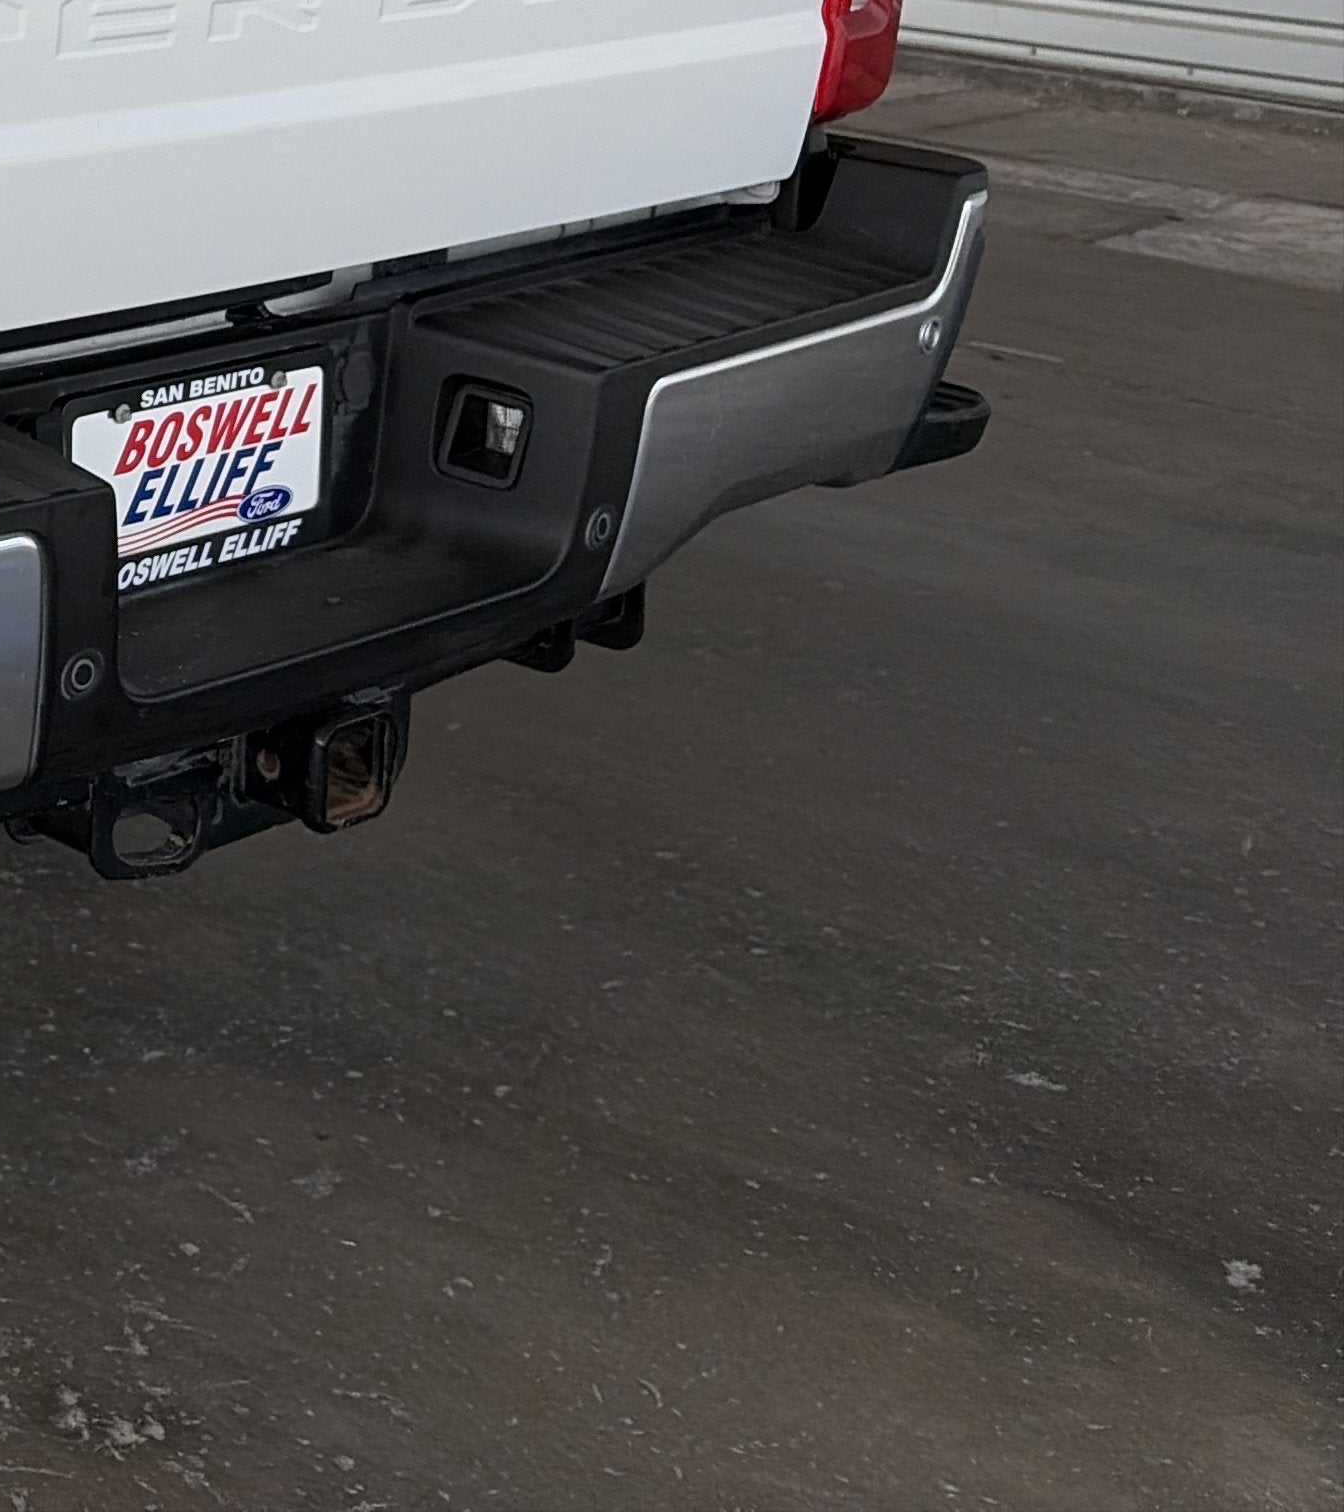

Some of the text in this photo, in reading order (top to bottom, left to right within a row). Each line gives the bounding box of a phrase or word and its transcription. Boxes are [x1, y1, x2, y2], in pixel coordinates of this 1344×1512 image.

[139, 366, 265, 409] SAN BENITO
[113, 382, 319, 476] BOSWELL
[121, 439, 284, 527] ELLIFF
[246, 490, 283, 519] Ford
[117, 517, 303, 591] OSWELL ELLIFF
